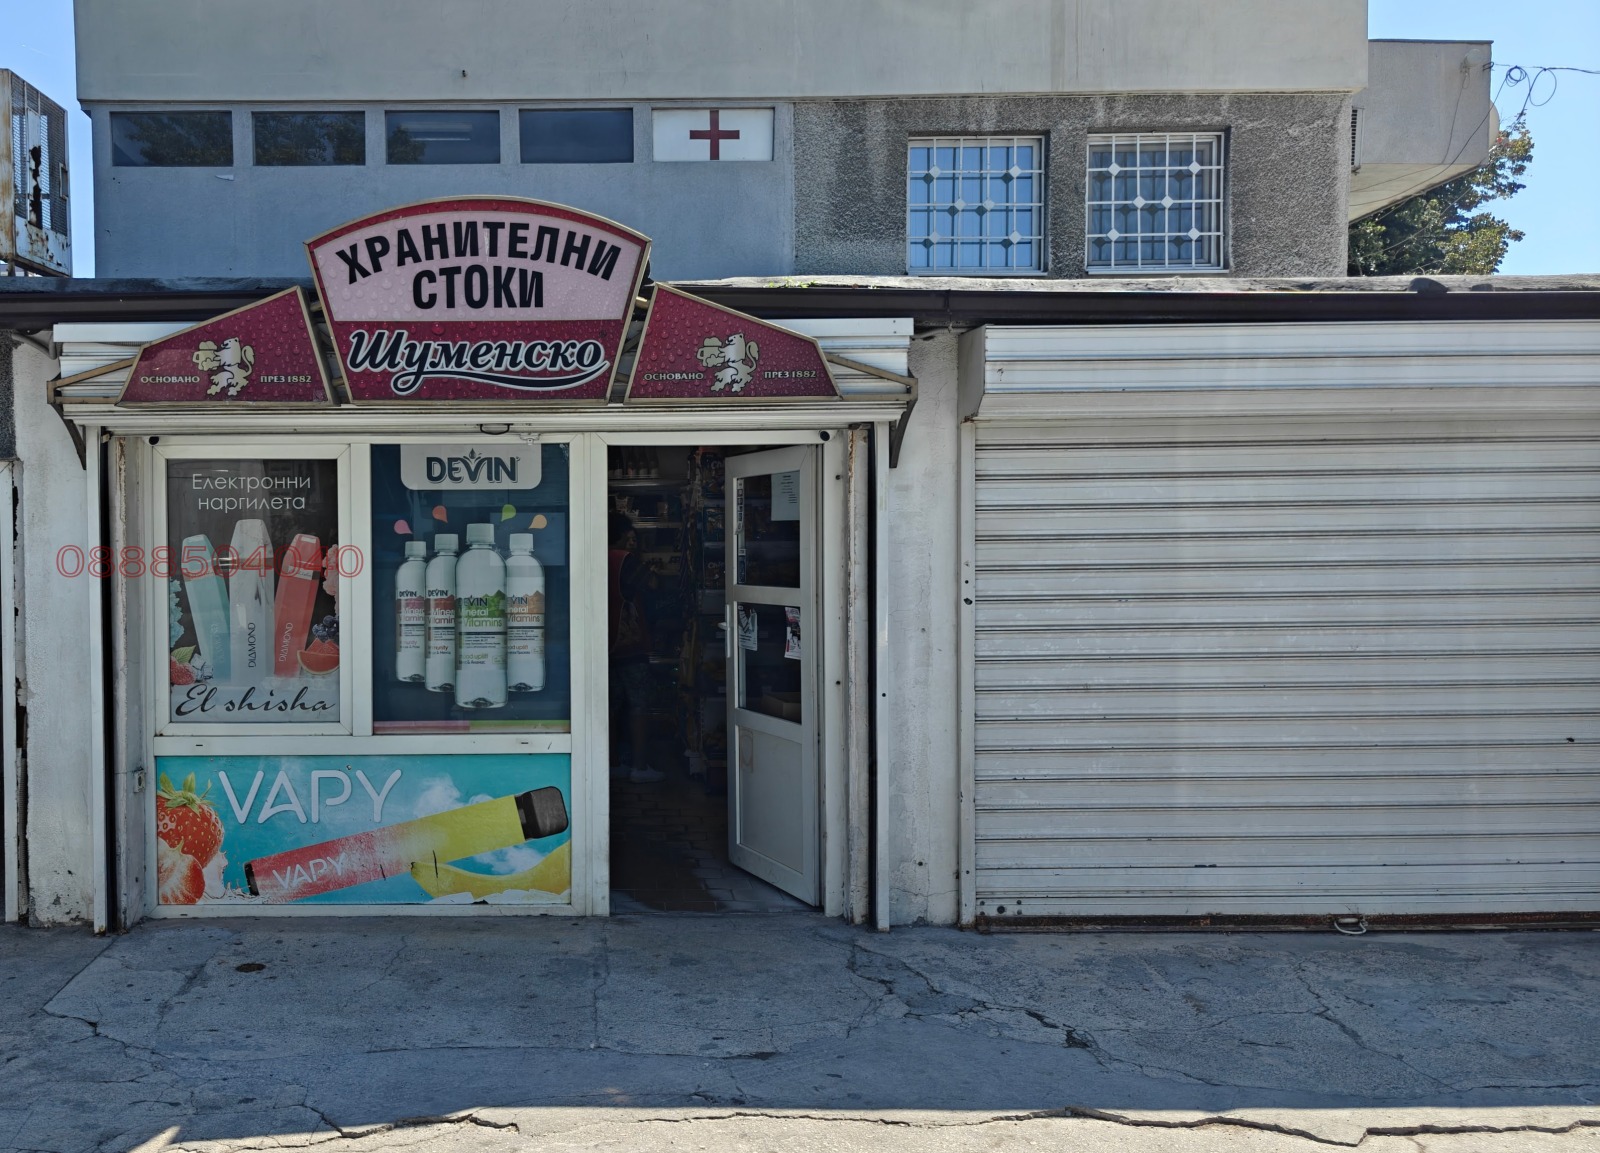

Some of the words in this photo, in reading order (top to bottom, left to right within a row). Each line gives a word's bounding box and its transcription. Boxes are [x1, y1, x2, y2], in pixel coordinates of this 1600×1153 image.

[335, 221, 622, 285] ХРАНИТЕЛНИ
[411, 265, 545, 309] СТОКИ
[347, 329, 611, 397] Шуменско
[764, 369, 791, 379] ПРЕЗ
[791, 369, 817, 379] 1882
[140, 375, 200, 384] ОСНОВАНО
[260, 374, 286, 384] ПРЕЗ
[287, 374, 313, 384] 1882
[644, 373, 704, 381] ОСНОВАНО
[425, 449, 519, 483] DEVIN
[192, 473, 311, 492] Електронни
[198, 496, 306, 514] наргилета
[399, 589, 417, 598] DEVIN
[428, 588, 448, 598] DEVIN
[507, 594, 528, 605] EVIN
[247, 622, 257, 668] DIAMOND
[278, 622, 294, 662] DIAMOND
[175, 683, 218, 717] El
[223, 686, 336, 713] shisha
[218, 769, 402, 825] VAPY
[272, 853, 347, 889] VAPY
